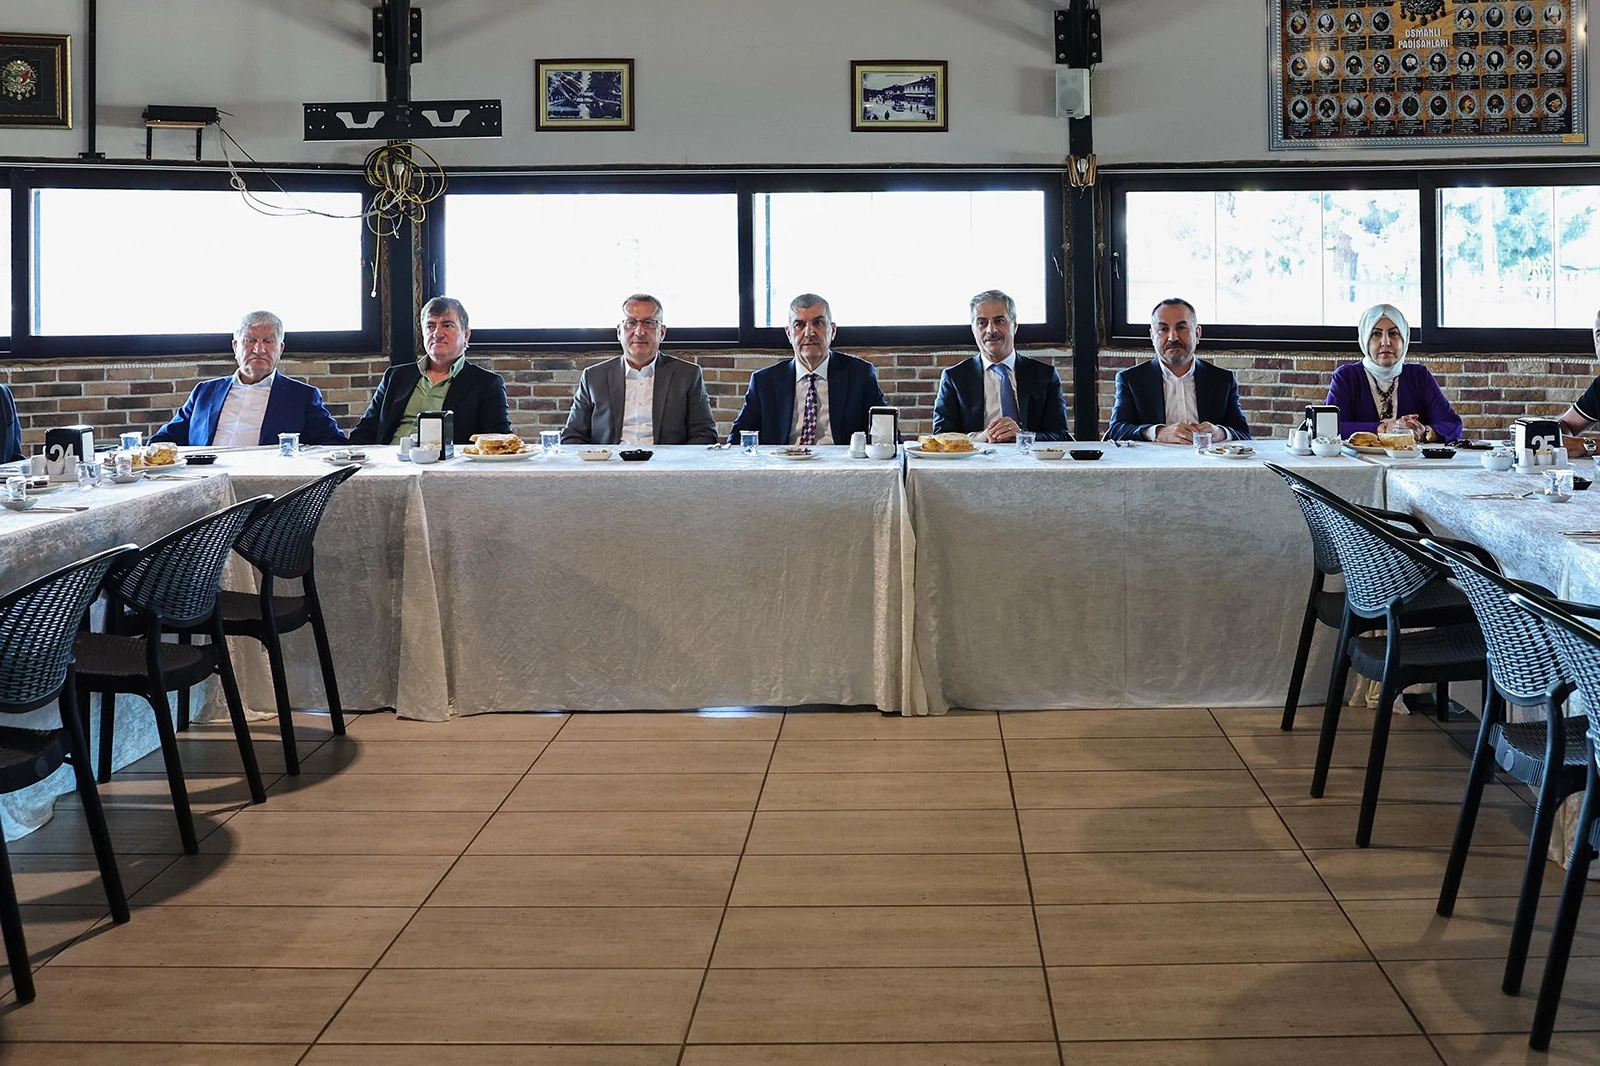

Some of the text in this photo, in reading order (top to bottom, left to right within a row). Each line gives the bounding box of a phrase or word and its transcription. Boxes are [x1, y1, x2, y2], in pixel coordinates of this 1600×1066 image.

[1405, 28, 1441, 38] OSMANLI
[1398, 38, 1449, 49] PADİŞAHLARI
[1531, 435, 1555, 452] 25
[50, 444, 74, 462] 24
